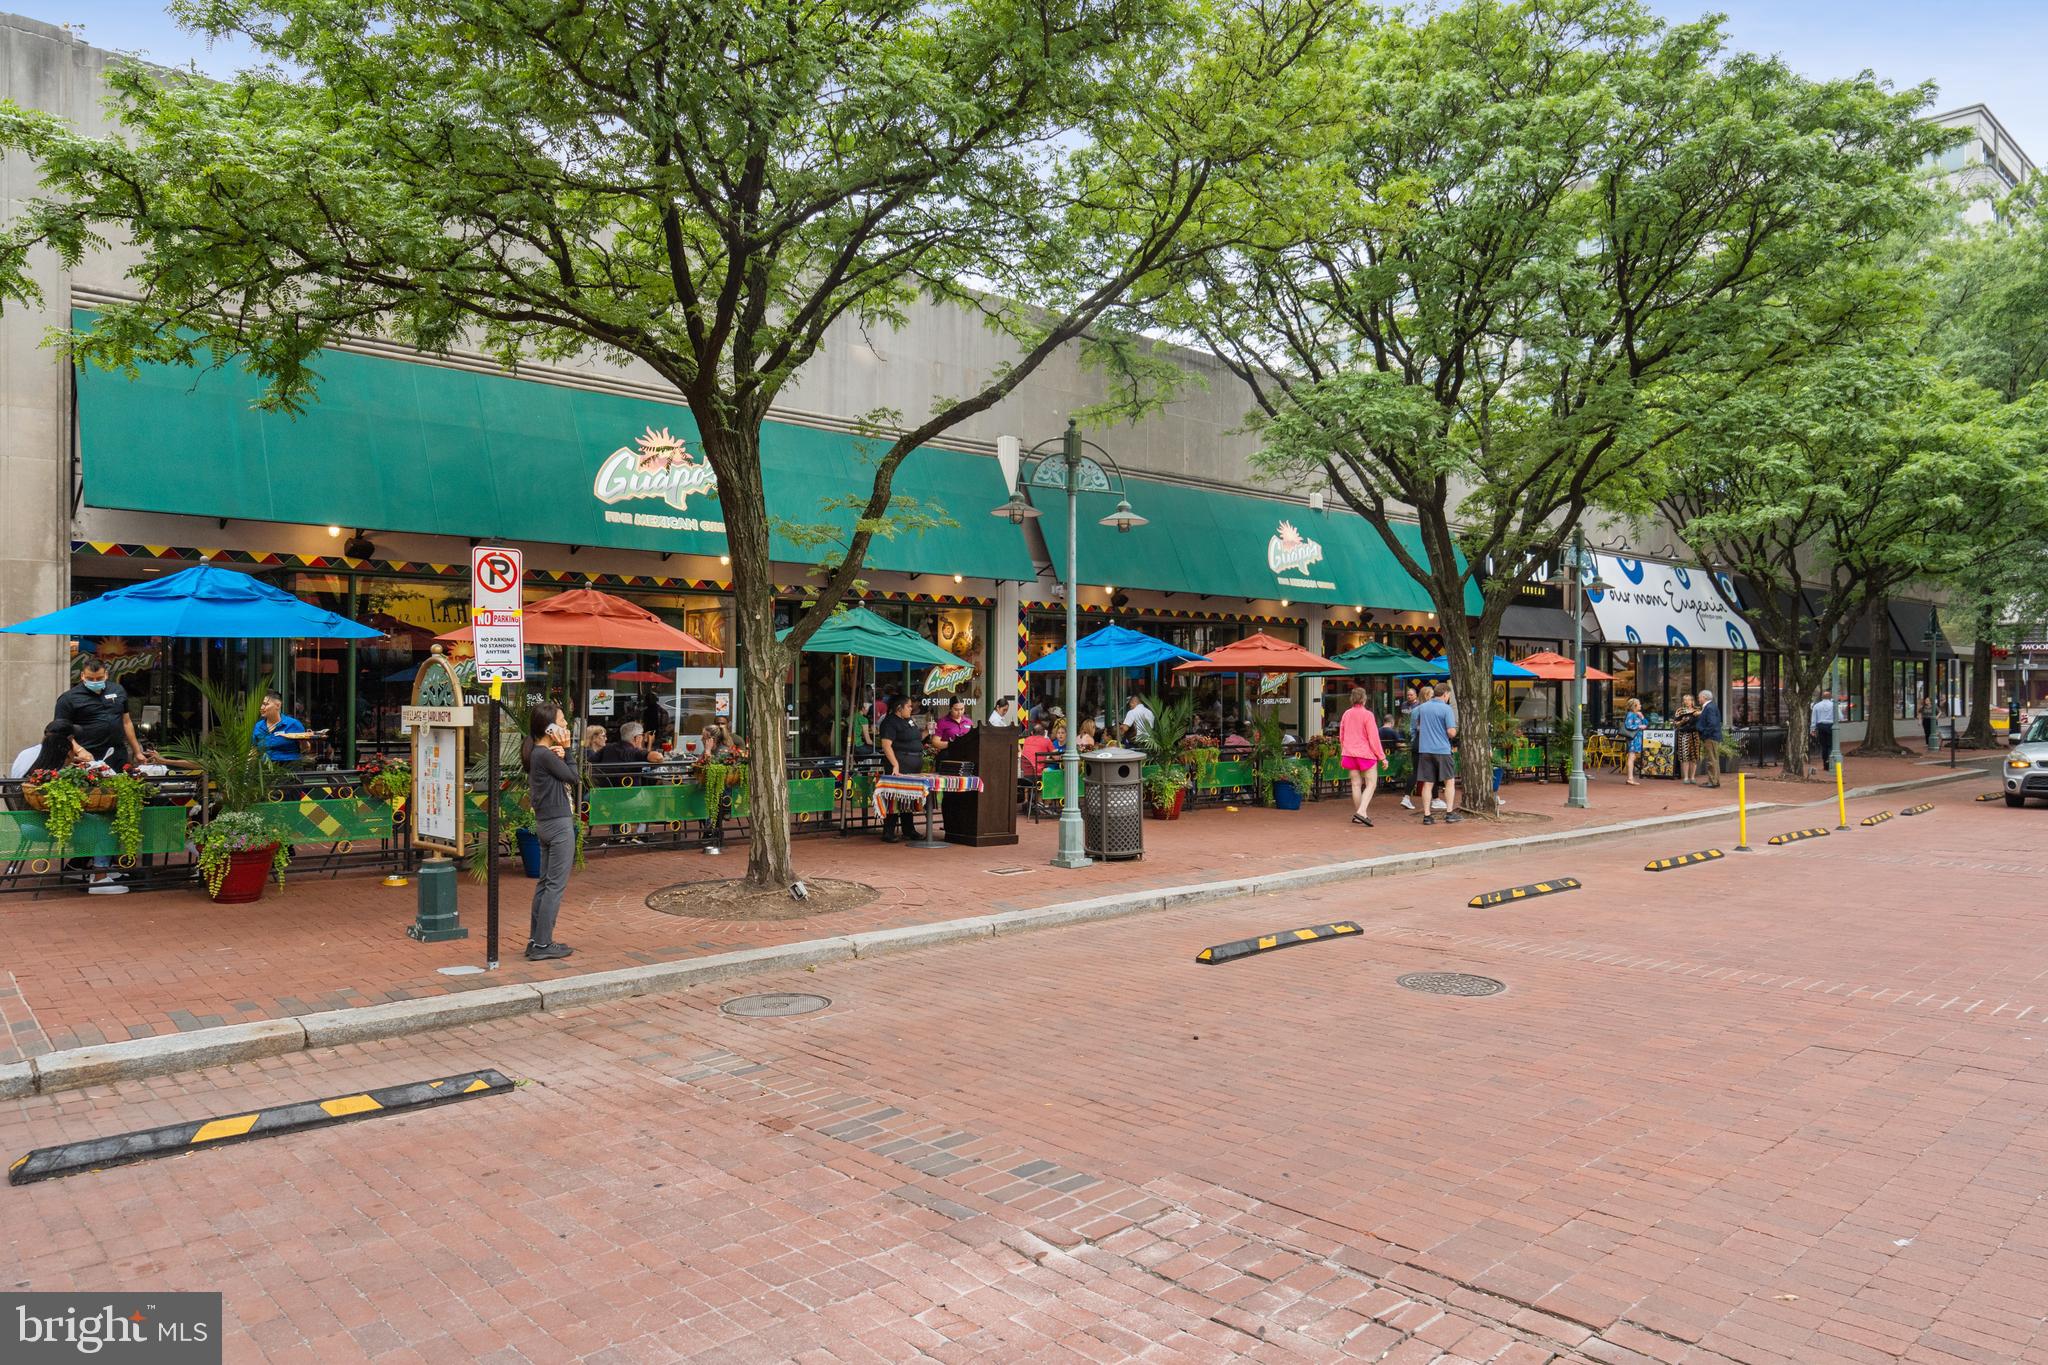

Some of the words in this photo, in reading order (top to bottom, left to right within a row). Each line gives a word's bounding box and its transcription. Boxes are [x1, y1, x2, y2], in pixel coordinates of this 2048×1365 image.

[634, 514, 699, 531] MEXICAN
[1633, 594, 1667, 606] mom
[1664, 580, 1727, 632] Eugenia
[477, 612, 491, 625] NO
[494, 615, 519, 623] PARKING
